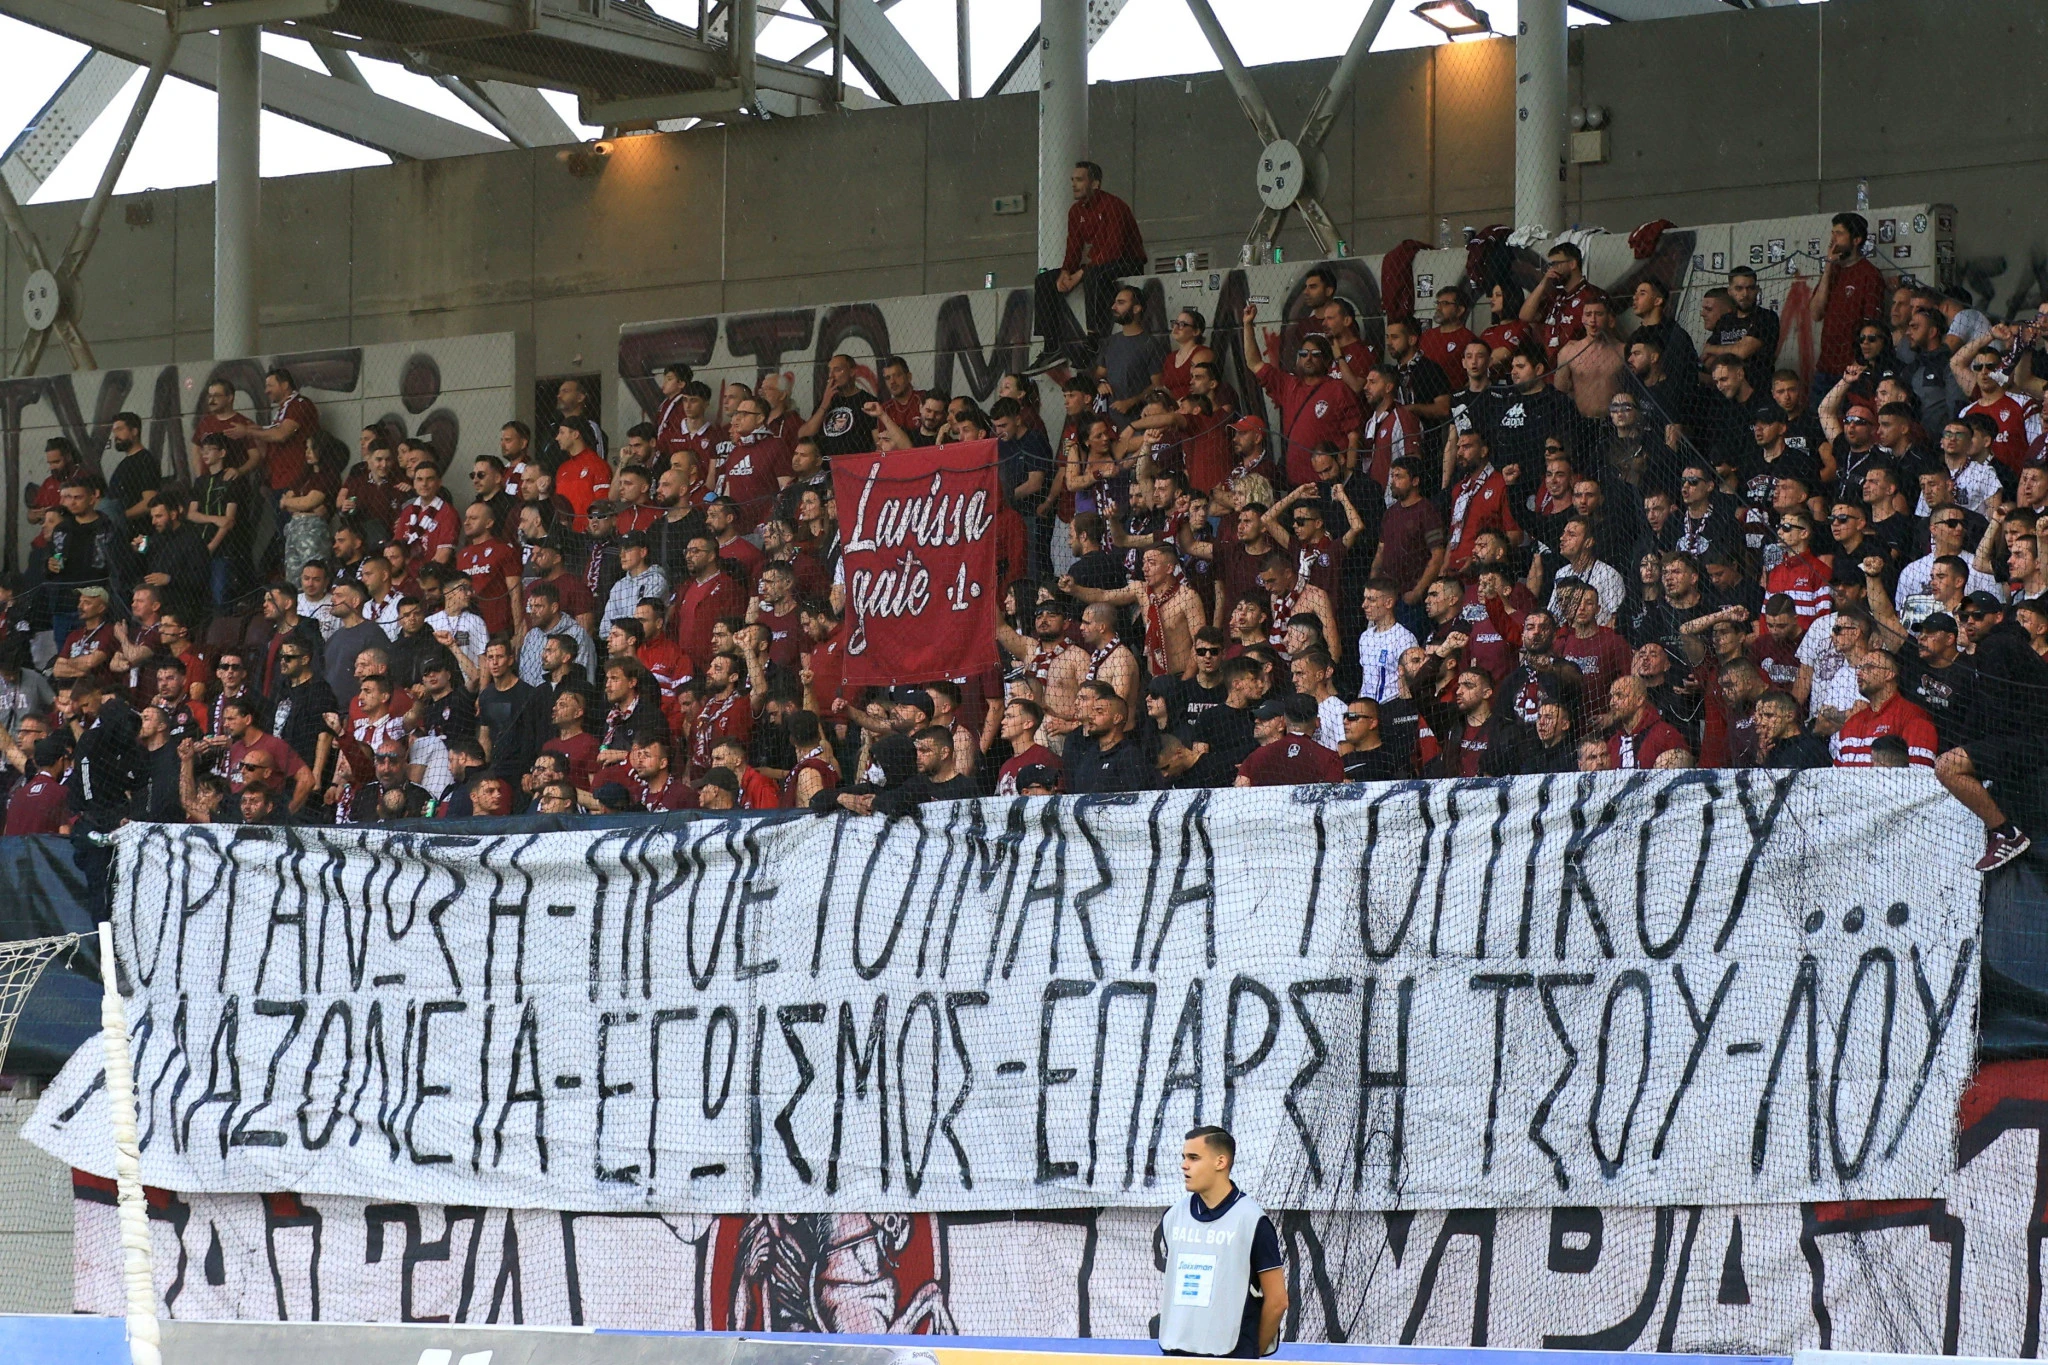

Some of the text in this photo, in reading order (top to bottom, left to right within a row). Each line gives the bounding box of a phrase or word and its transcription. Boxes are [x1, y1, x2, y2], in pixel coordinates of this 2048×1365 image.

[729, 466, 753, 476] adidas
[844, 461, 993, 555] Larissa
[848, 550, 930, 655] gate
[1172, 1226, 1236, 1246] BALL BOY
